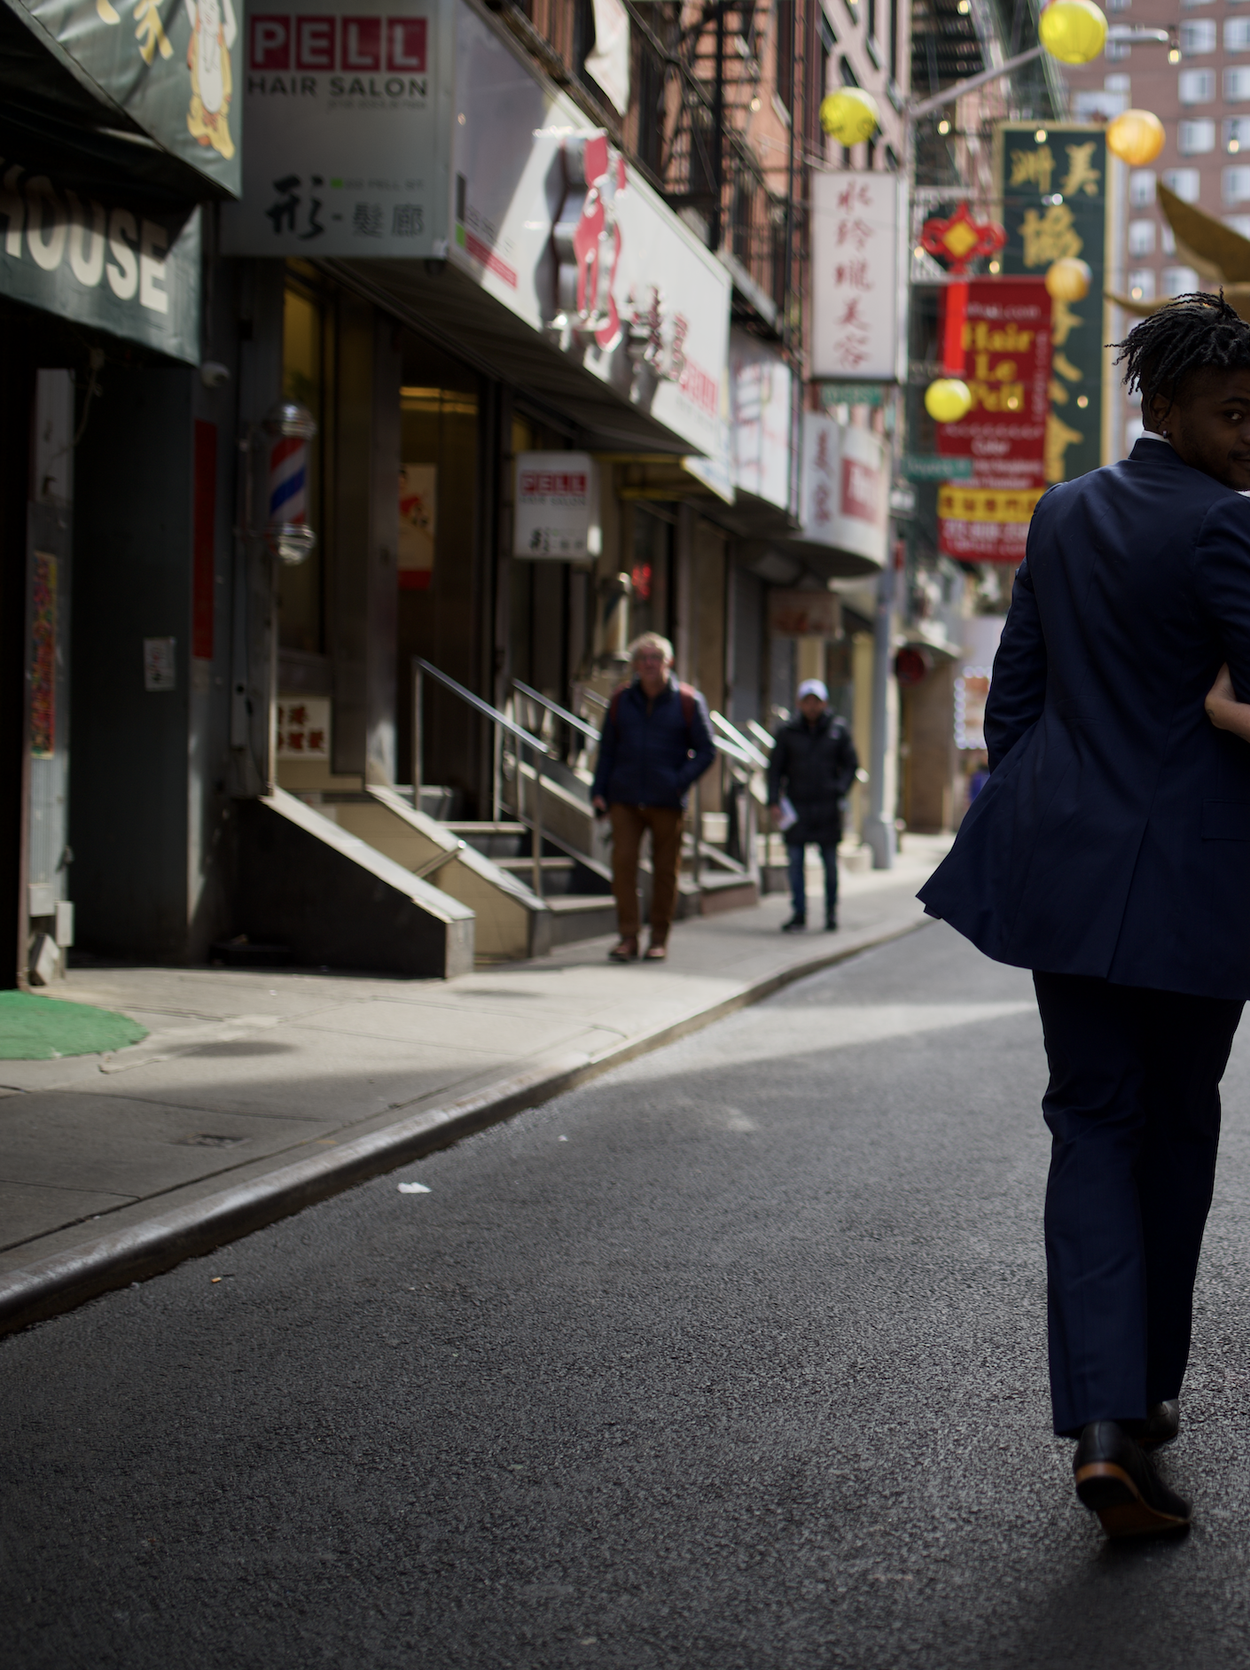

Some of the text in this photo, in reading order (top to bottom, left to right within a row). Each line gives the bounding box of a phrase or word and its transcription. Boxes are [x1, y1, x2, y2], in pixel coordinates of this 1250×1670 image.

[253, 21, 422, 67] PELL
[248, 76, 427, 97] HAIR SALON
[521, 475, 586, 496] PELL
